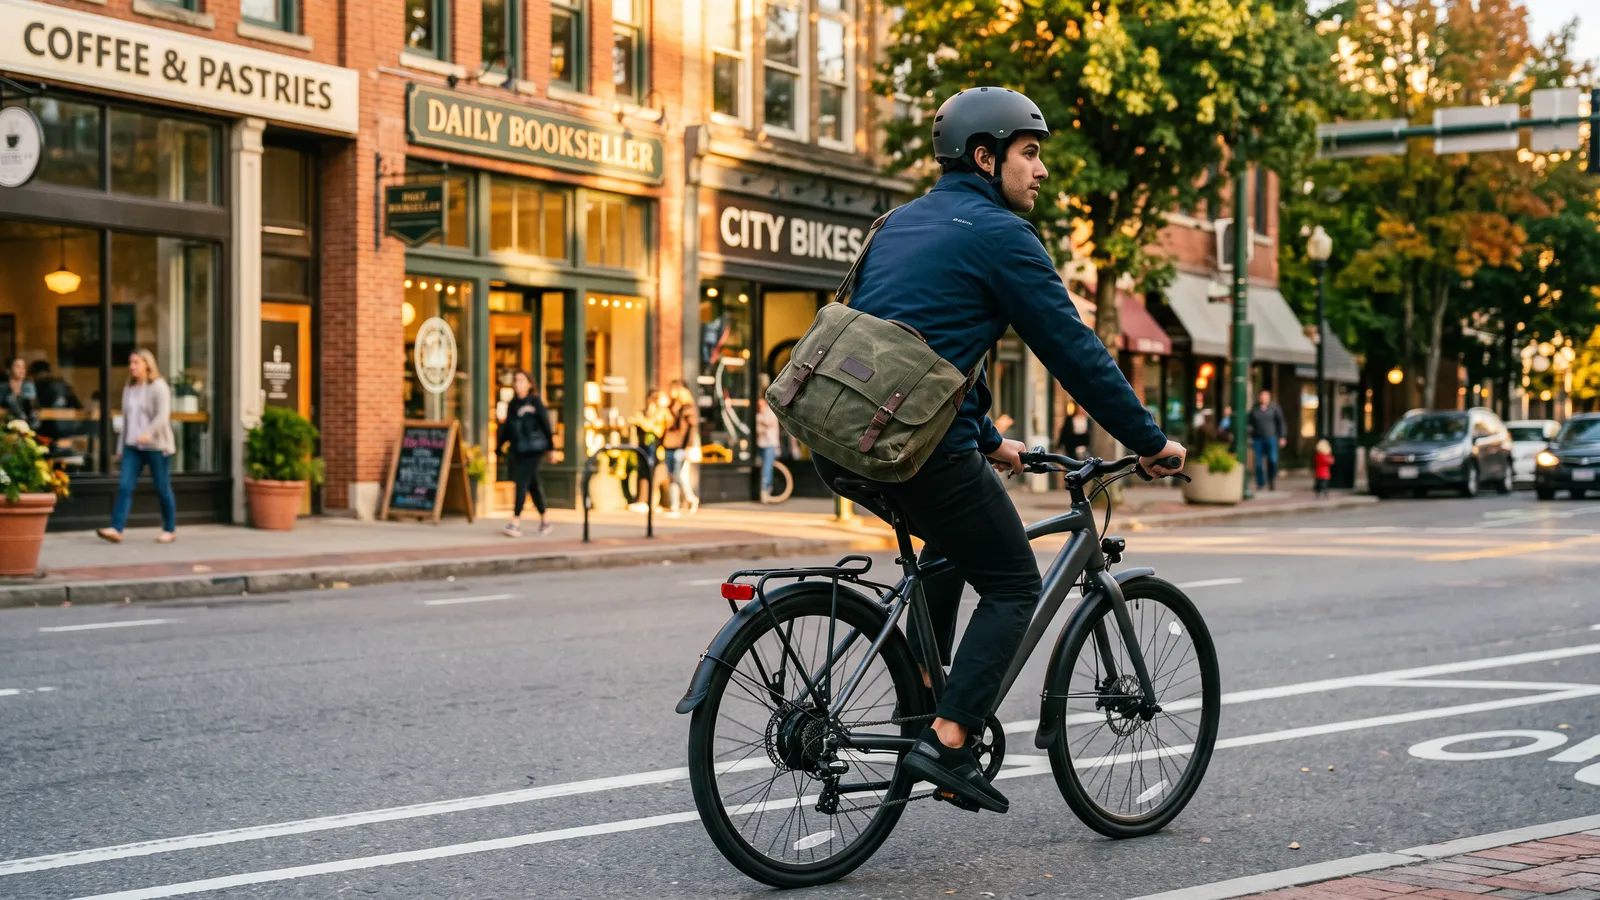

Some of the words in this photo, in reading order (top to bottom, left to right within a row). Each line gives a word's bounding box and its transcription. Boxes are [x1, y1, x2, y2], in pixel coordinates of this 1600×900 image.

[24, 22, 149, 76] COFFEE
[162, 50, 188, 83] &
[200, 56, 332, 110] PASTRIES
[428, 98, 503, 143] DAILY
[508, 115, 654, 172] BOOKSELLER
[720, 206, 785, 252] CITY
[791, 218, 863, 263] BIKES
